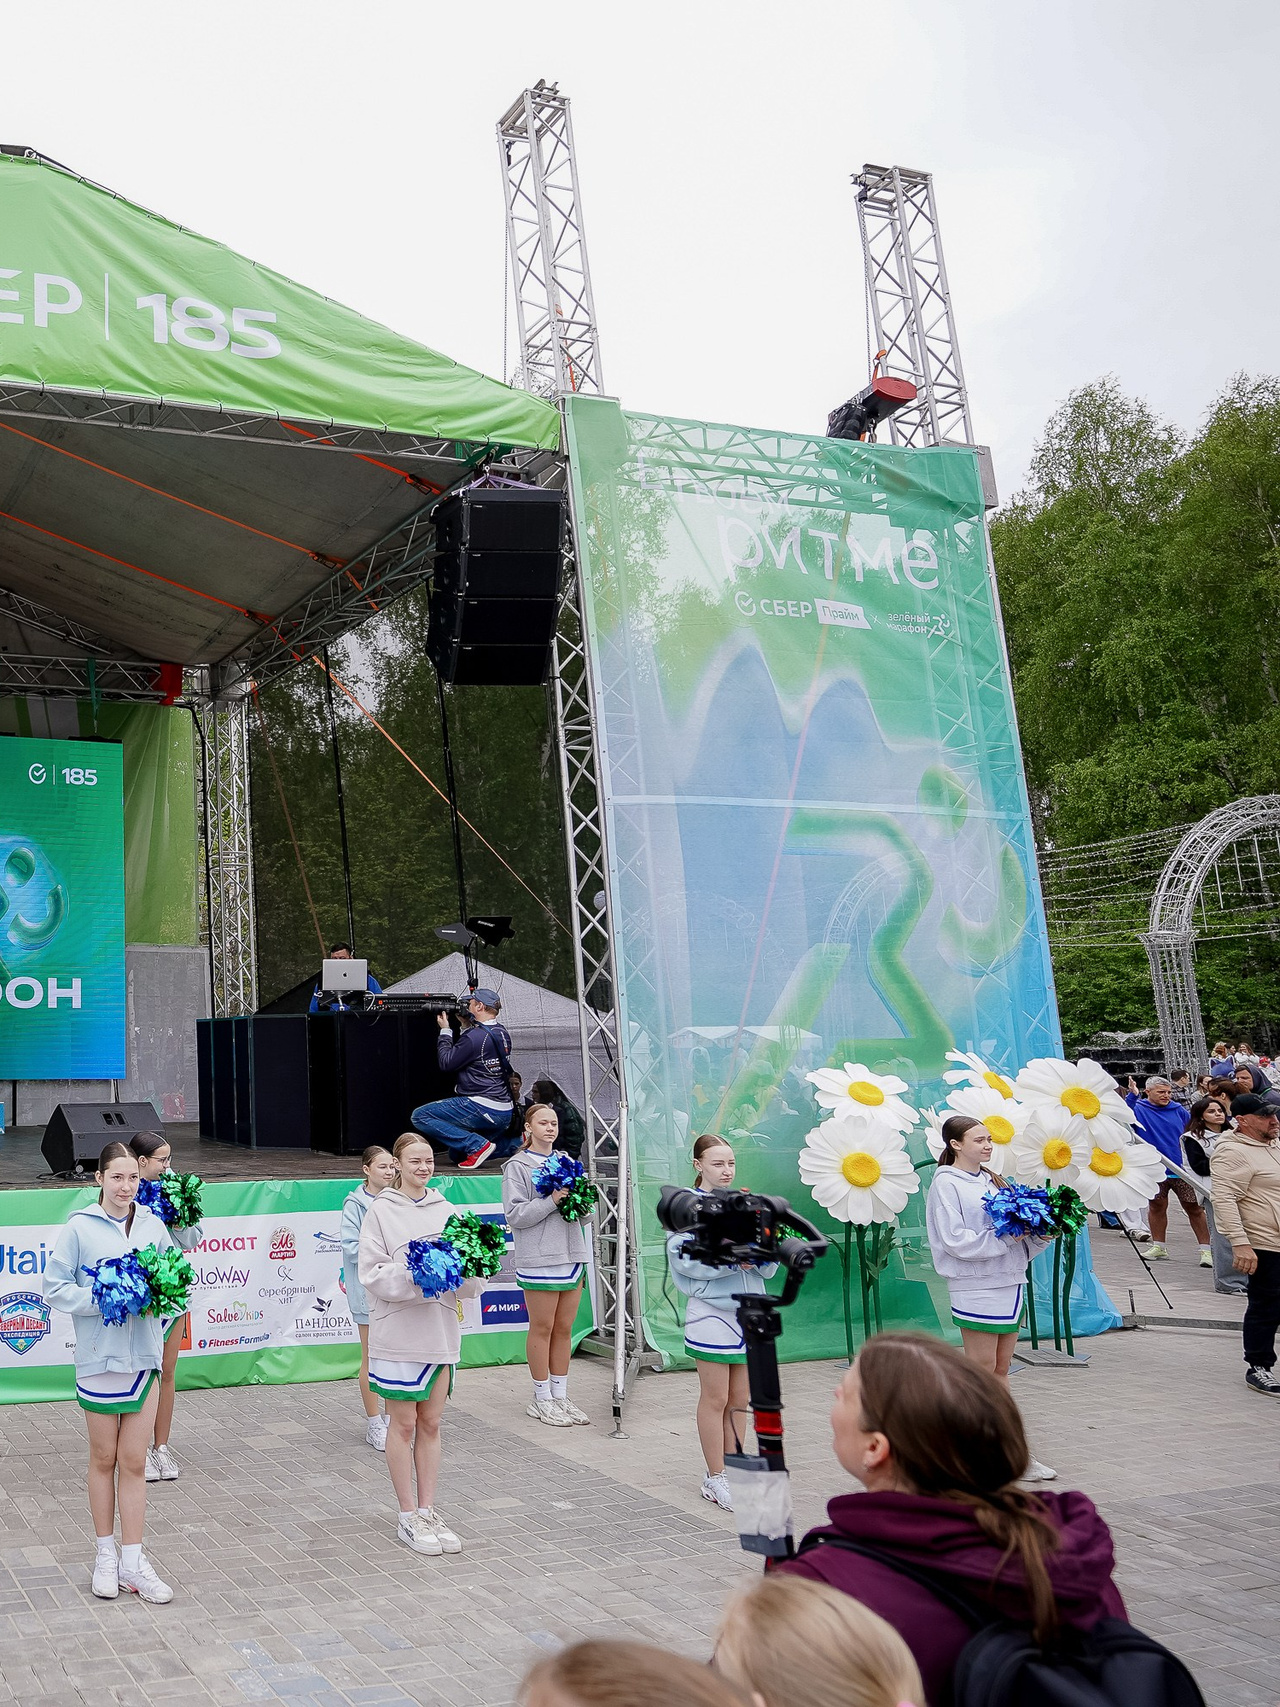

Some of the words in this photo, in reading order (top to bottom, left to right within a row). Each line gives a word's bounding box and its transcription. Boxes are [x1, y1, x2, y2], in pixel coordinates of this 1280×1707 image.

[136, 293, 281, 359] 185
[717, 515, 939, 590] ритме
[760, 599, 812, 618] СБЕР
[822, 606, 859, 621] Прайм
[887, 612, 930, 623] зелёный
[885, 622, 927, 634] марафон
[62, 768, 98, 786] 185
[258, 1285, 316, 1298] Серебряный
[207, 1308, 239, 1323] Salve
